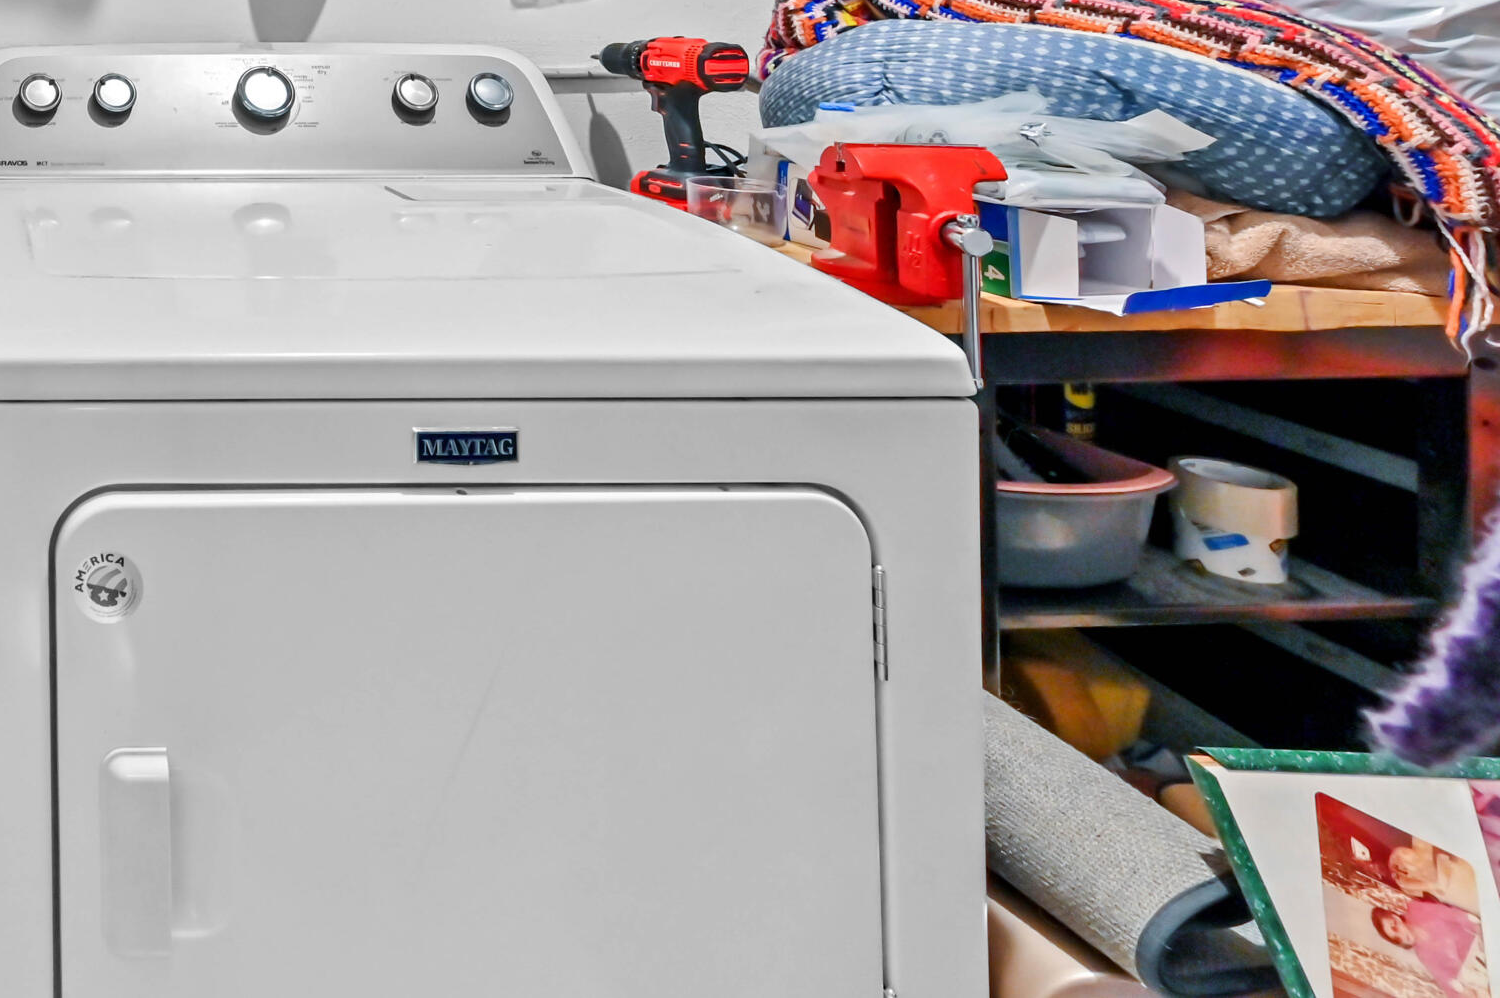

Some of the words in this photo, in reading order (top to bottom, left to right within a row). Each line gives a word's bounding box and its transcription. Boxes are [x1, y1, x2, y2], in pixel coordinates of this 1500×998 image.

[983, 264, 1006, 281] 4
[422, 438, 514, 456] MAYTAG
[75, 553, 125, 593] AMERICA
